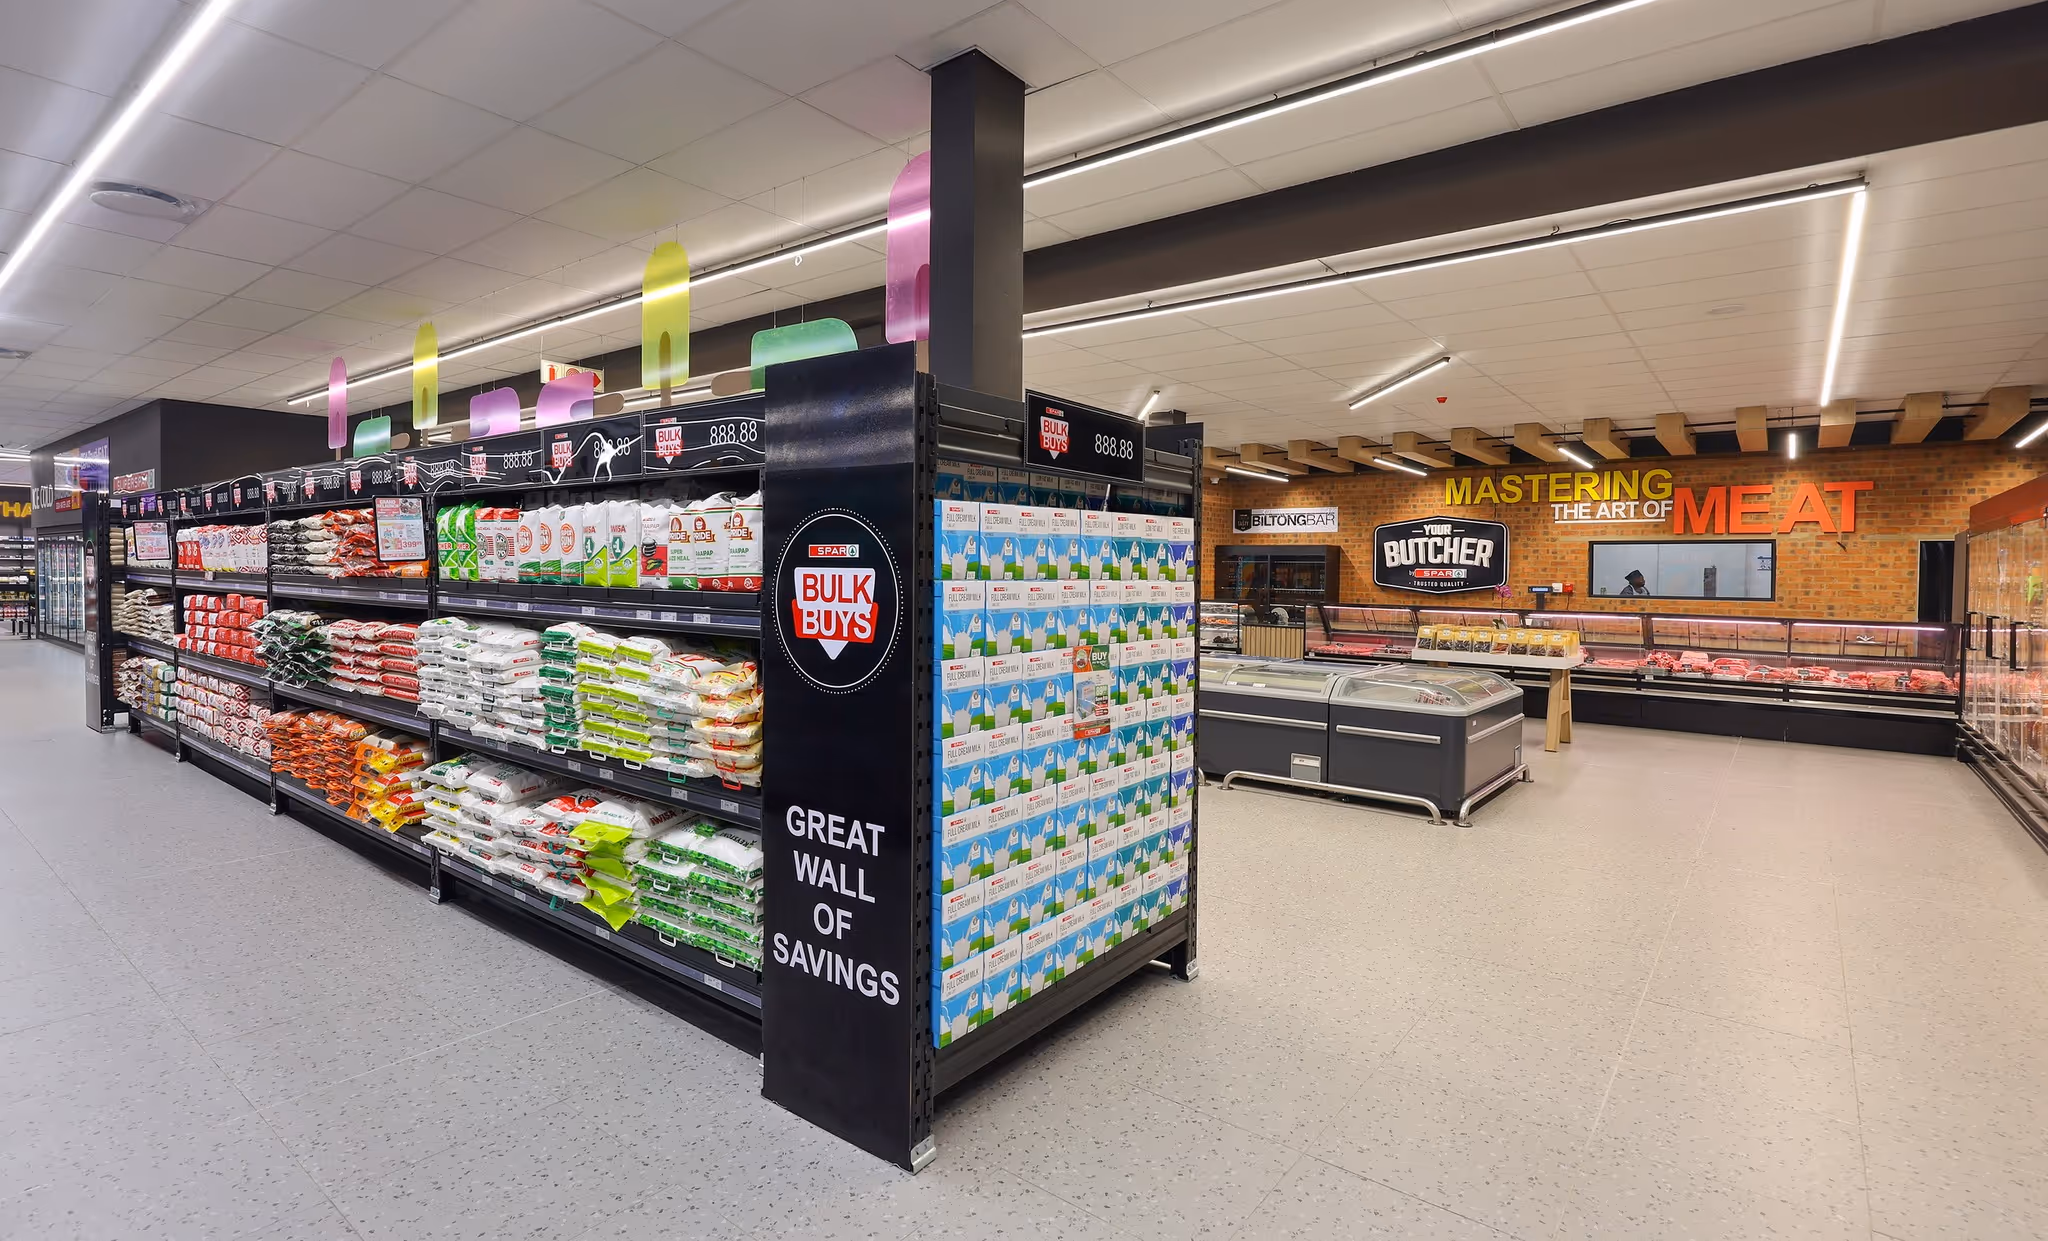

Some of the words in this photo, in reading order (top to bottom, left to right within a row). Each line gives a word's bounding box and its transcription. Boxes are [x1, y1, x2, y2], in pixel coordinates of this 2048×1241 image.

[658, 428, 681, 442] BULK
[710, 420, 758, 445] 888.88
[1044, 420, 1068, 436] BULK
[554, 444, 572, 455] BULK
[1043, 436, 1068, 452] BUYS
[1095, 434, 1134, 460] 888.88
[472, 456, 486, 466] BULK
[504, 450, 533, 470] 888.88
[1445, 470, 1673, 505] MASTERING
[1550, 502, 1592, 520] THE
[1595, 501, 1636, 519] ART
[1642, 500, 1675, 518] OF
[1673, 480, 1874, 534] MEAT
[1423, 524, 1452, 536] YOUR
[818, 547, 846, 555] SPAR
[1384, 537, 1494, 568] BUTCHER
[803, 574, 872, 604] BULK
[802, 609, 872, 639] BUYS
[1092, 652, 1107, 660] BUY
[786, 805, 885, 856] GREAT
[793, 850, 875, 903] WALL
[813, 902, 852, 940] OF
[773, 932, 900, 1006] SAVINGS
